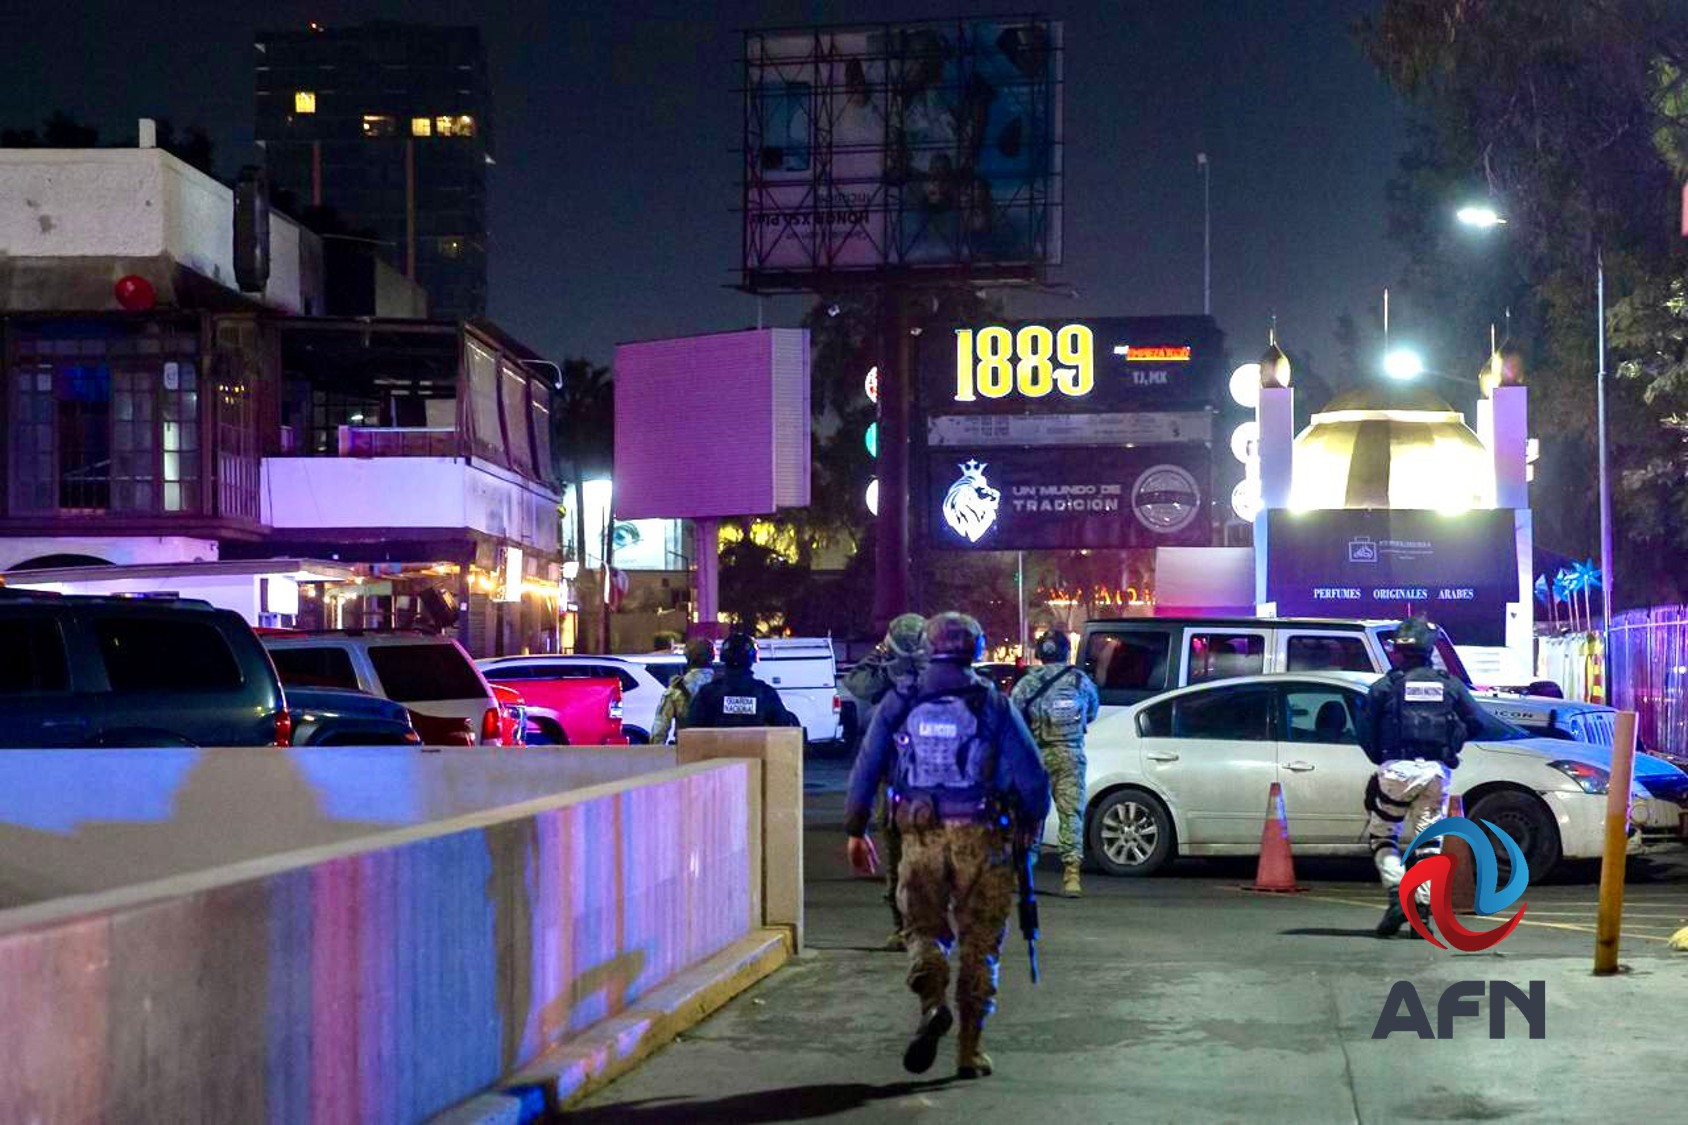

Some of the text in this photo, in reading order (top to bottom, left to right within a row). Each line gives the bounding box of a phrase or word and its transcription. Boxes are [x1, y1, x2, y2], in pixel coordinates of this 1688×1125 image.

[954, 324, 1094, 401] 1889
[1012, 484, 1121, 496] UN MUNDO DE
[1313, 588, 1474, 599] PERFUMES ORIGINALES ARABES
